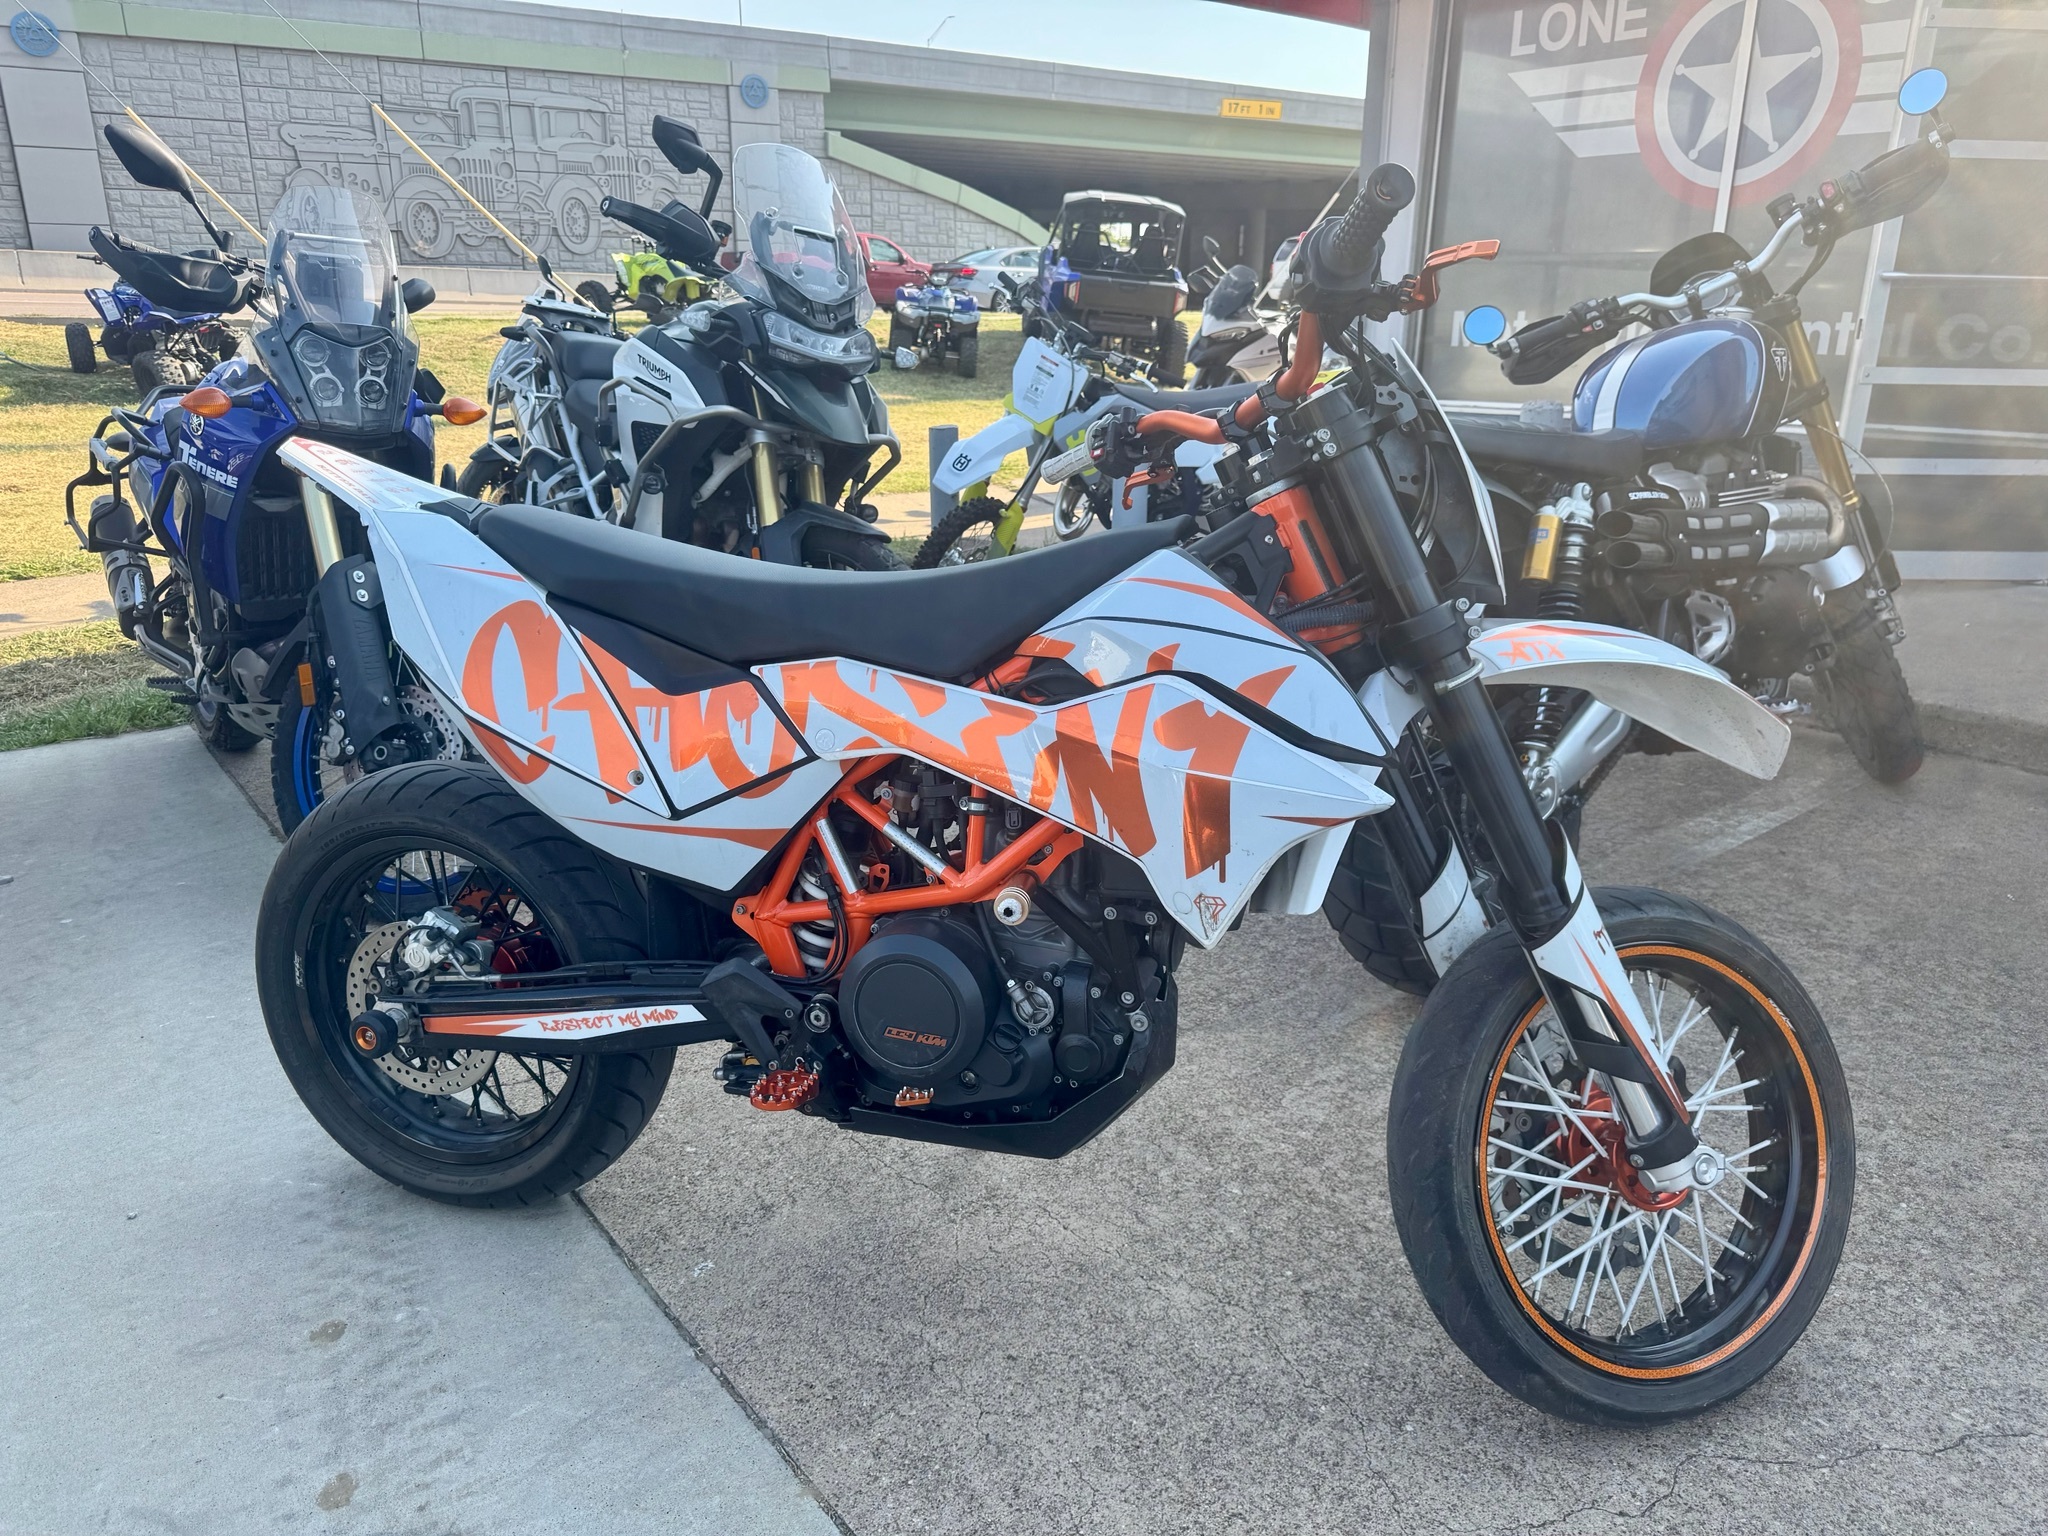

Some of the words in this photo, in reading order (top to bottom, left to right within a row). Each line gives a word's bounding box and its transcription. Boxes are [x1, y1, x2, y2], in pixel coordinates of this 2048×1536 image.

[1510, 0, 1648, 57] LONE
[321, 162, 380, 196] 1920s
[637, 353, 671, 384] TRIUMPH
[1497, 639, 1566, 666] ATX
[538, 1014, 614, 1032] RESPECT
[617, 1010, 642, 1028] MY
[916, 1033, 947, 1047] KTM
